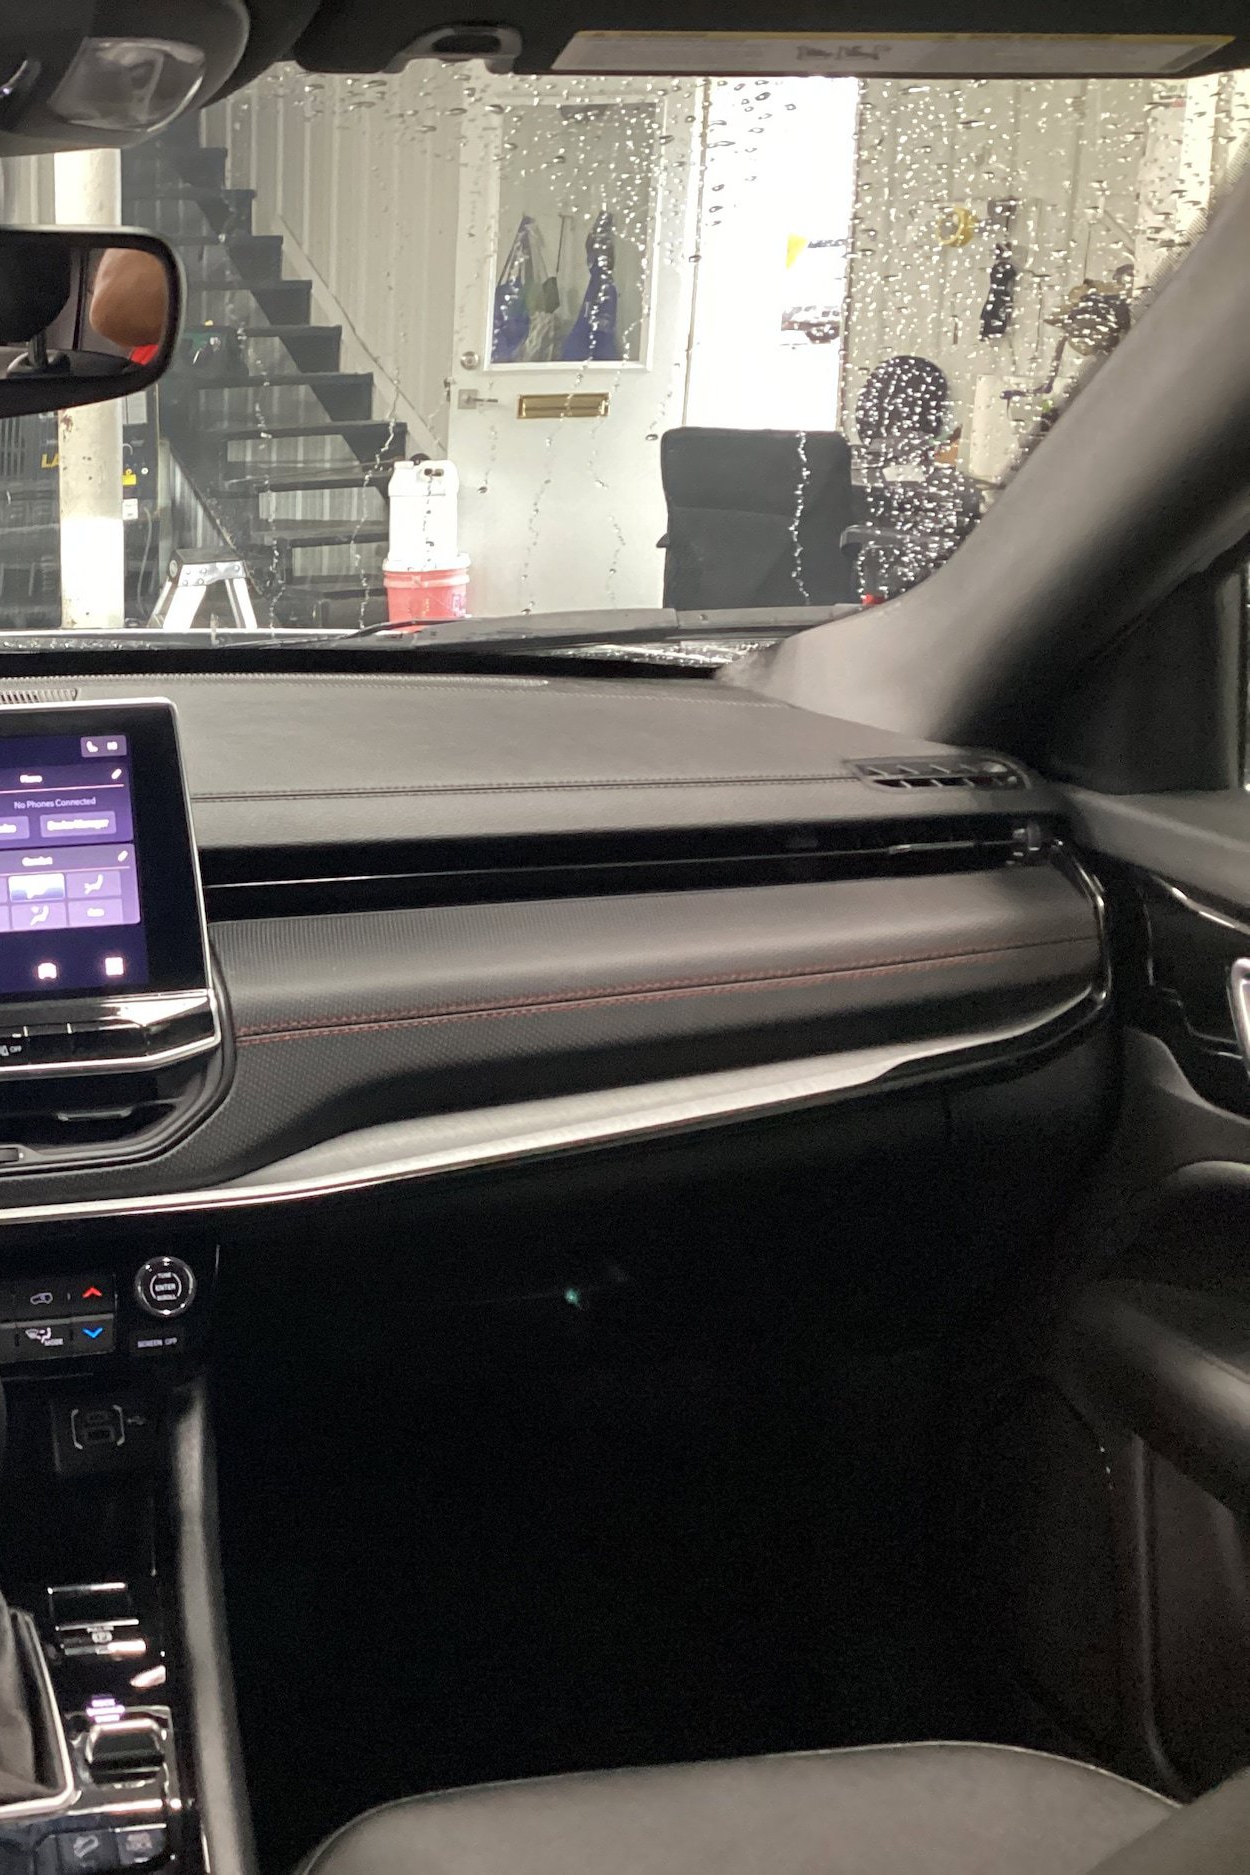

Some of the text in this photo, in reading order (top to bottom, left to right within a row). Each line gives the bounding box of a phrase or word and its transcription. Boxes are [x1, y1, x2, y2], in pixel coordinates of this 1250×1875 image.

[14, 797, 96, 810] No Phones Connected
